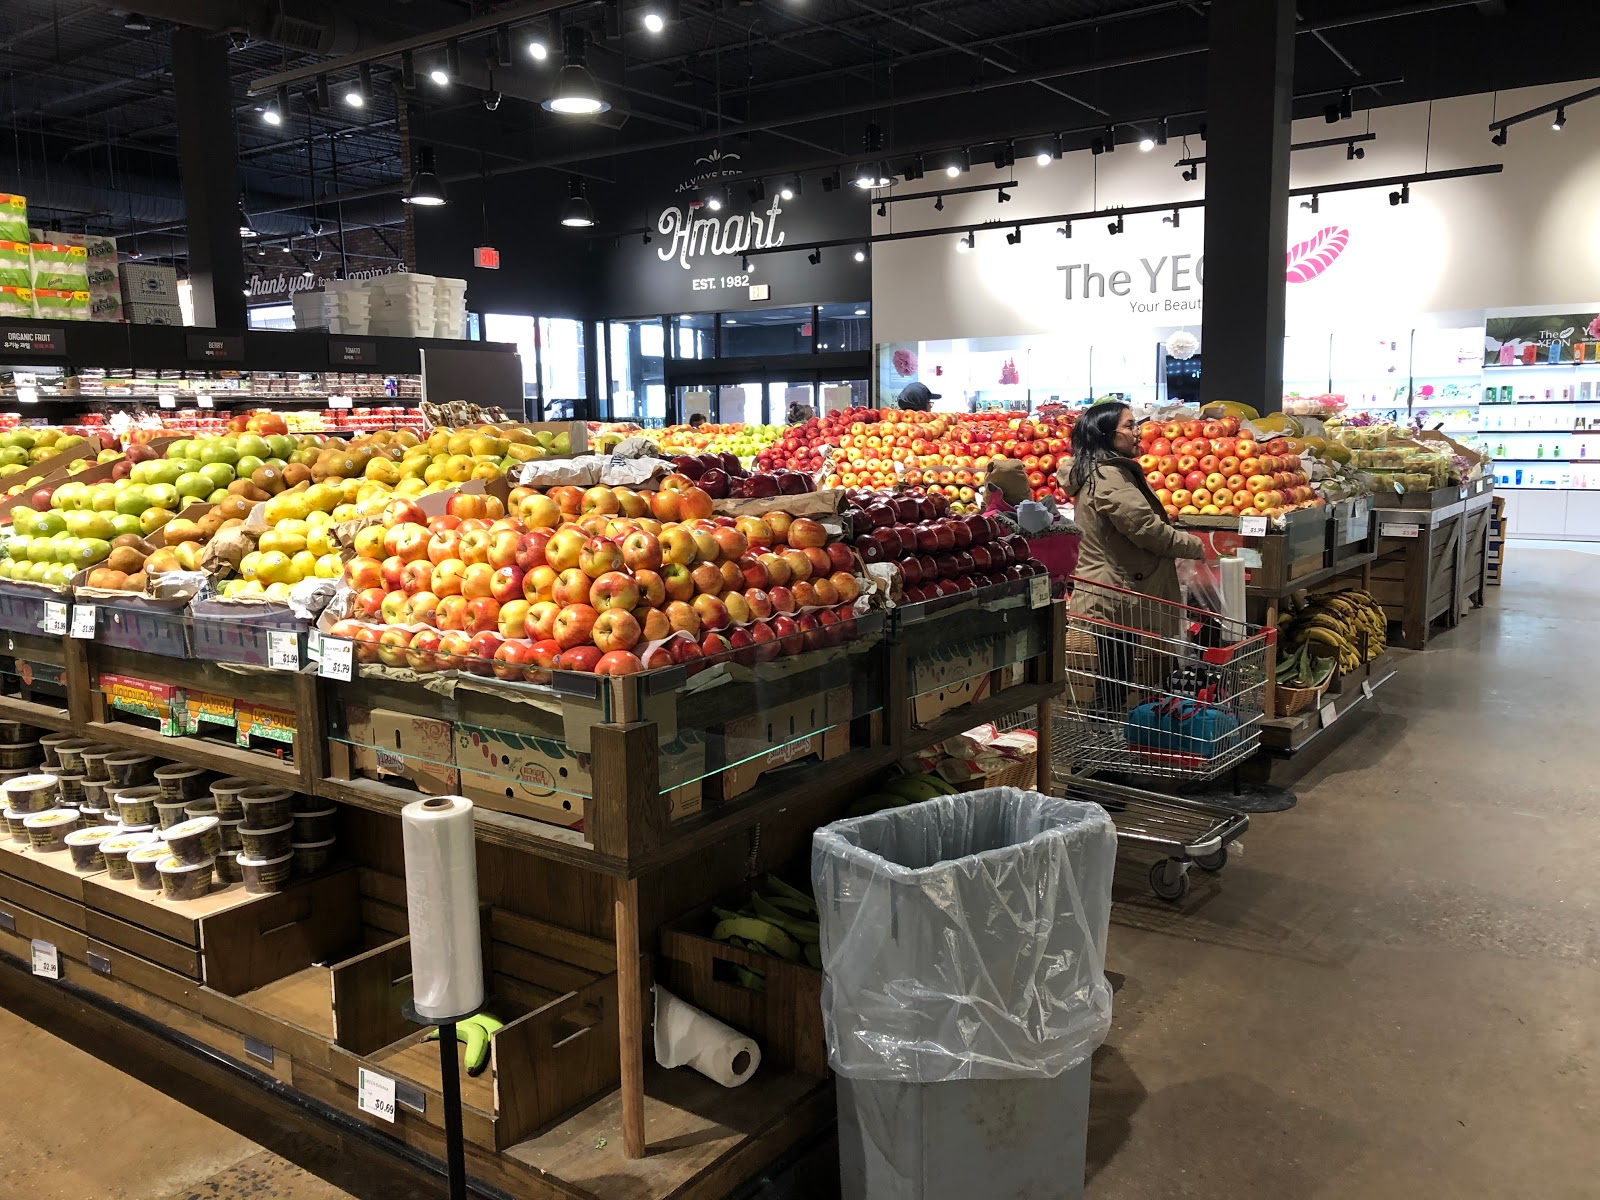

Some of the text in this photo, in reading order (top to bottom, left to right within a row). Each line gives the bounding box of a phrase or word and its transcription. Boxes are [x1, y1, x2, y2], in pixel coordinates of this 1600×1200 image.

[658, 194, 785, 270] Hmart
[140, 270, 164, 278] SKINNY
[1056, 253, 1204, 300] The YE
[250, 273, 287, 295] Thank
[288, 275, 316, 299] you
[692, 275, 750, 291] EST. 1982
[1130, 298, 1202, 313] Your Beaut
[144, 307, 171, 318] SKINNY
[7, 332, 51, 342] ORGANIC FRUIT
[1538, 330, 1560, 339] The
[208, 341, 224, 349] BERRY
[344, 346, 362, 354] TOMATO
[282, 653, 298, 664] $1.99
[332, 662, 350, 674] $1.79
[43, 962, 57, 972] $2.99
[374, 1099, 394, 1115] $0.69
